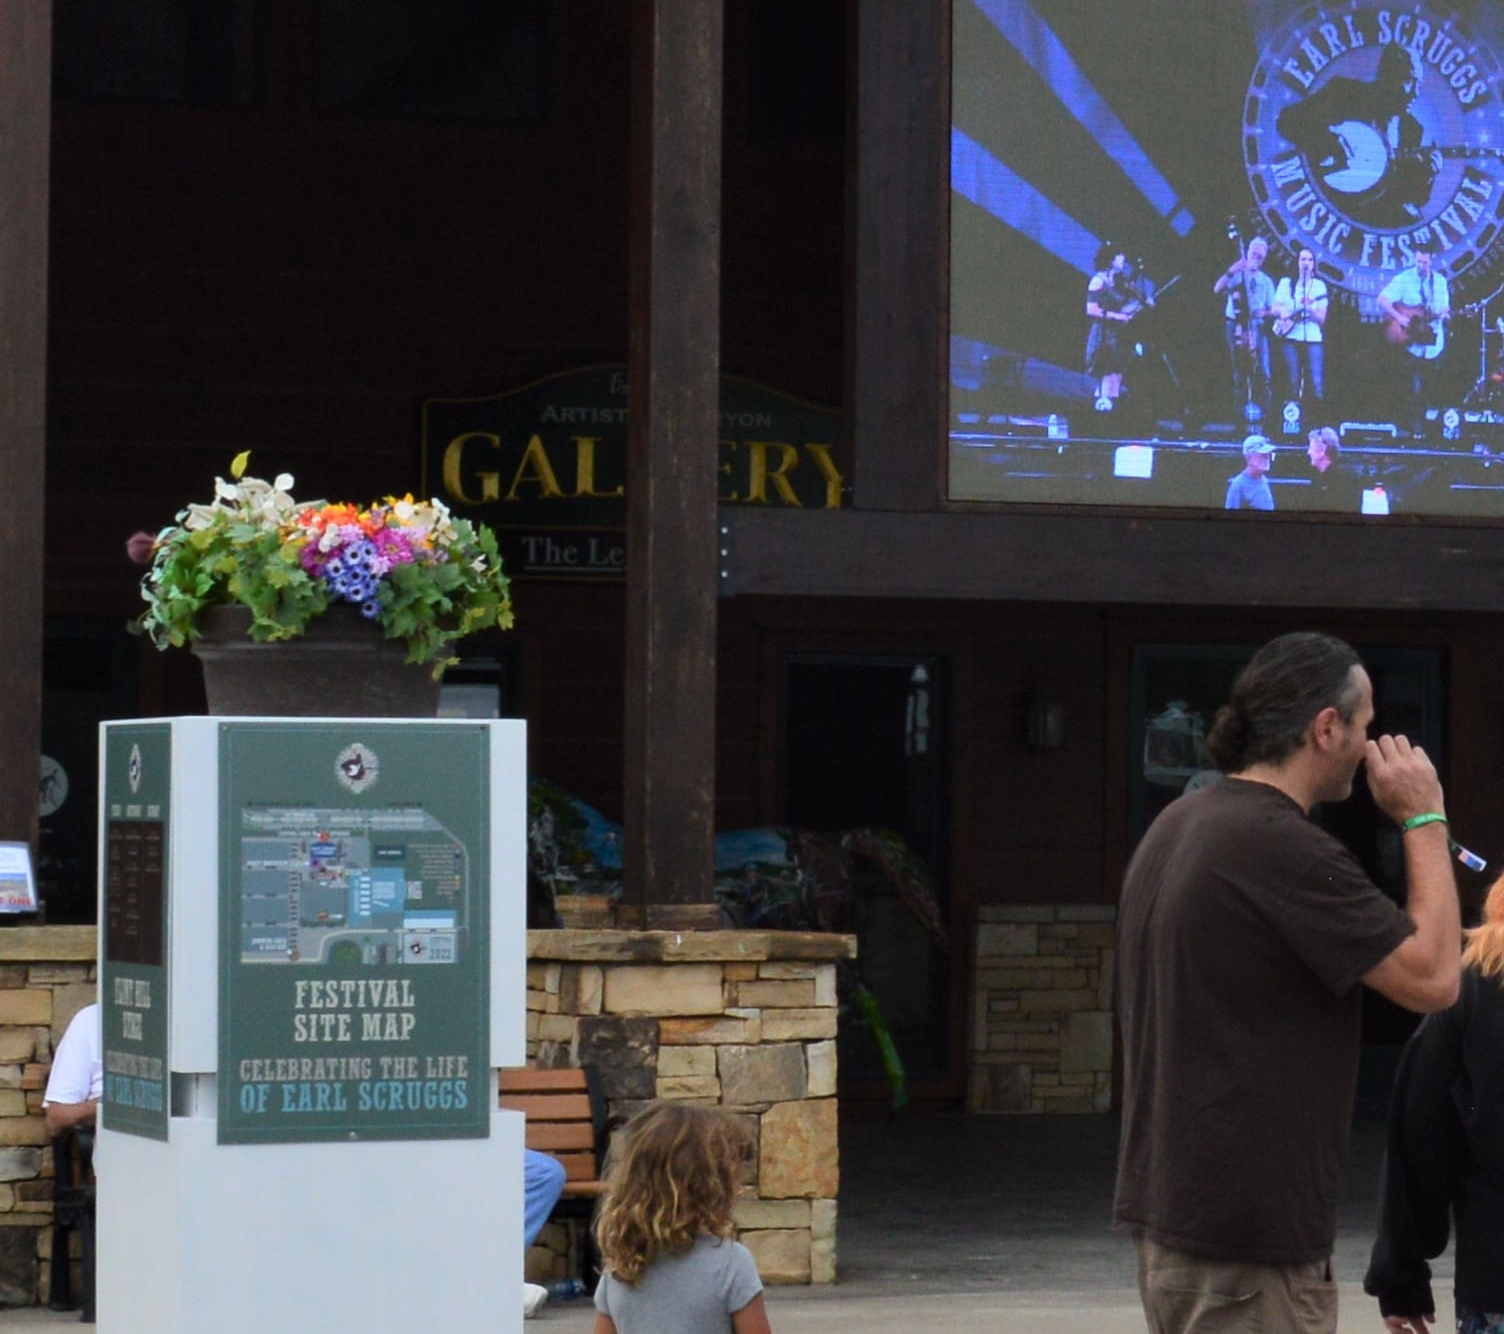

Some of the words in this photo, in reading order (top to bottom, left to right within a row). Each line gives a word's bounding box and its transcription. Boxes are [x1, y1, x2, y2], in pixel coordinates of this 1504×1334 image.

[1283, 14, 1365, 88] EARL
[1377, 10, 1488, 104] SCRUGGS
[1271, 155, 1352, 253] MUSIC
[442, 431, 844, 510] GALERY
[521, 536, 579, 566] The
[294, 979, 416, 1009] FESTIVAL
[294, 1013, 352, 1043] SITE
[360, 1012, 417, 1041] MAP
[239, 1056, 373, 1082] CELEBRATING
[380, 1055, 419, 1080] THE
[426, 1054, 469, 1079] LIFE
[239, 1082, 271, 1114] OF
[280, 1082, 349, 1113] EARL
[358, 1079, 470, 1111] SCRUGGS
